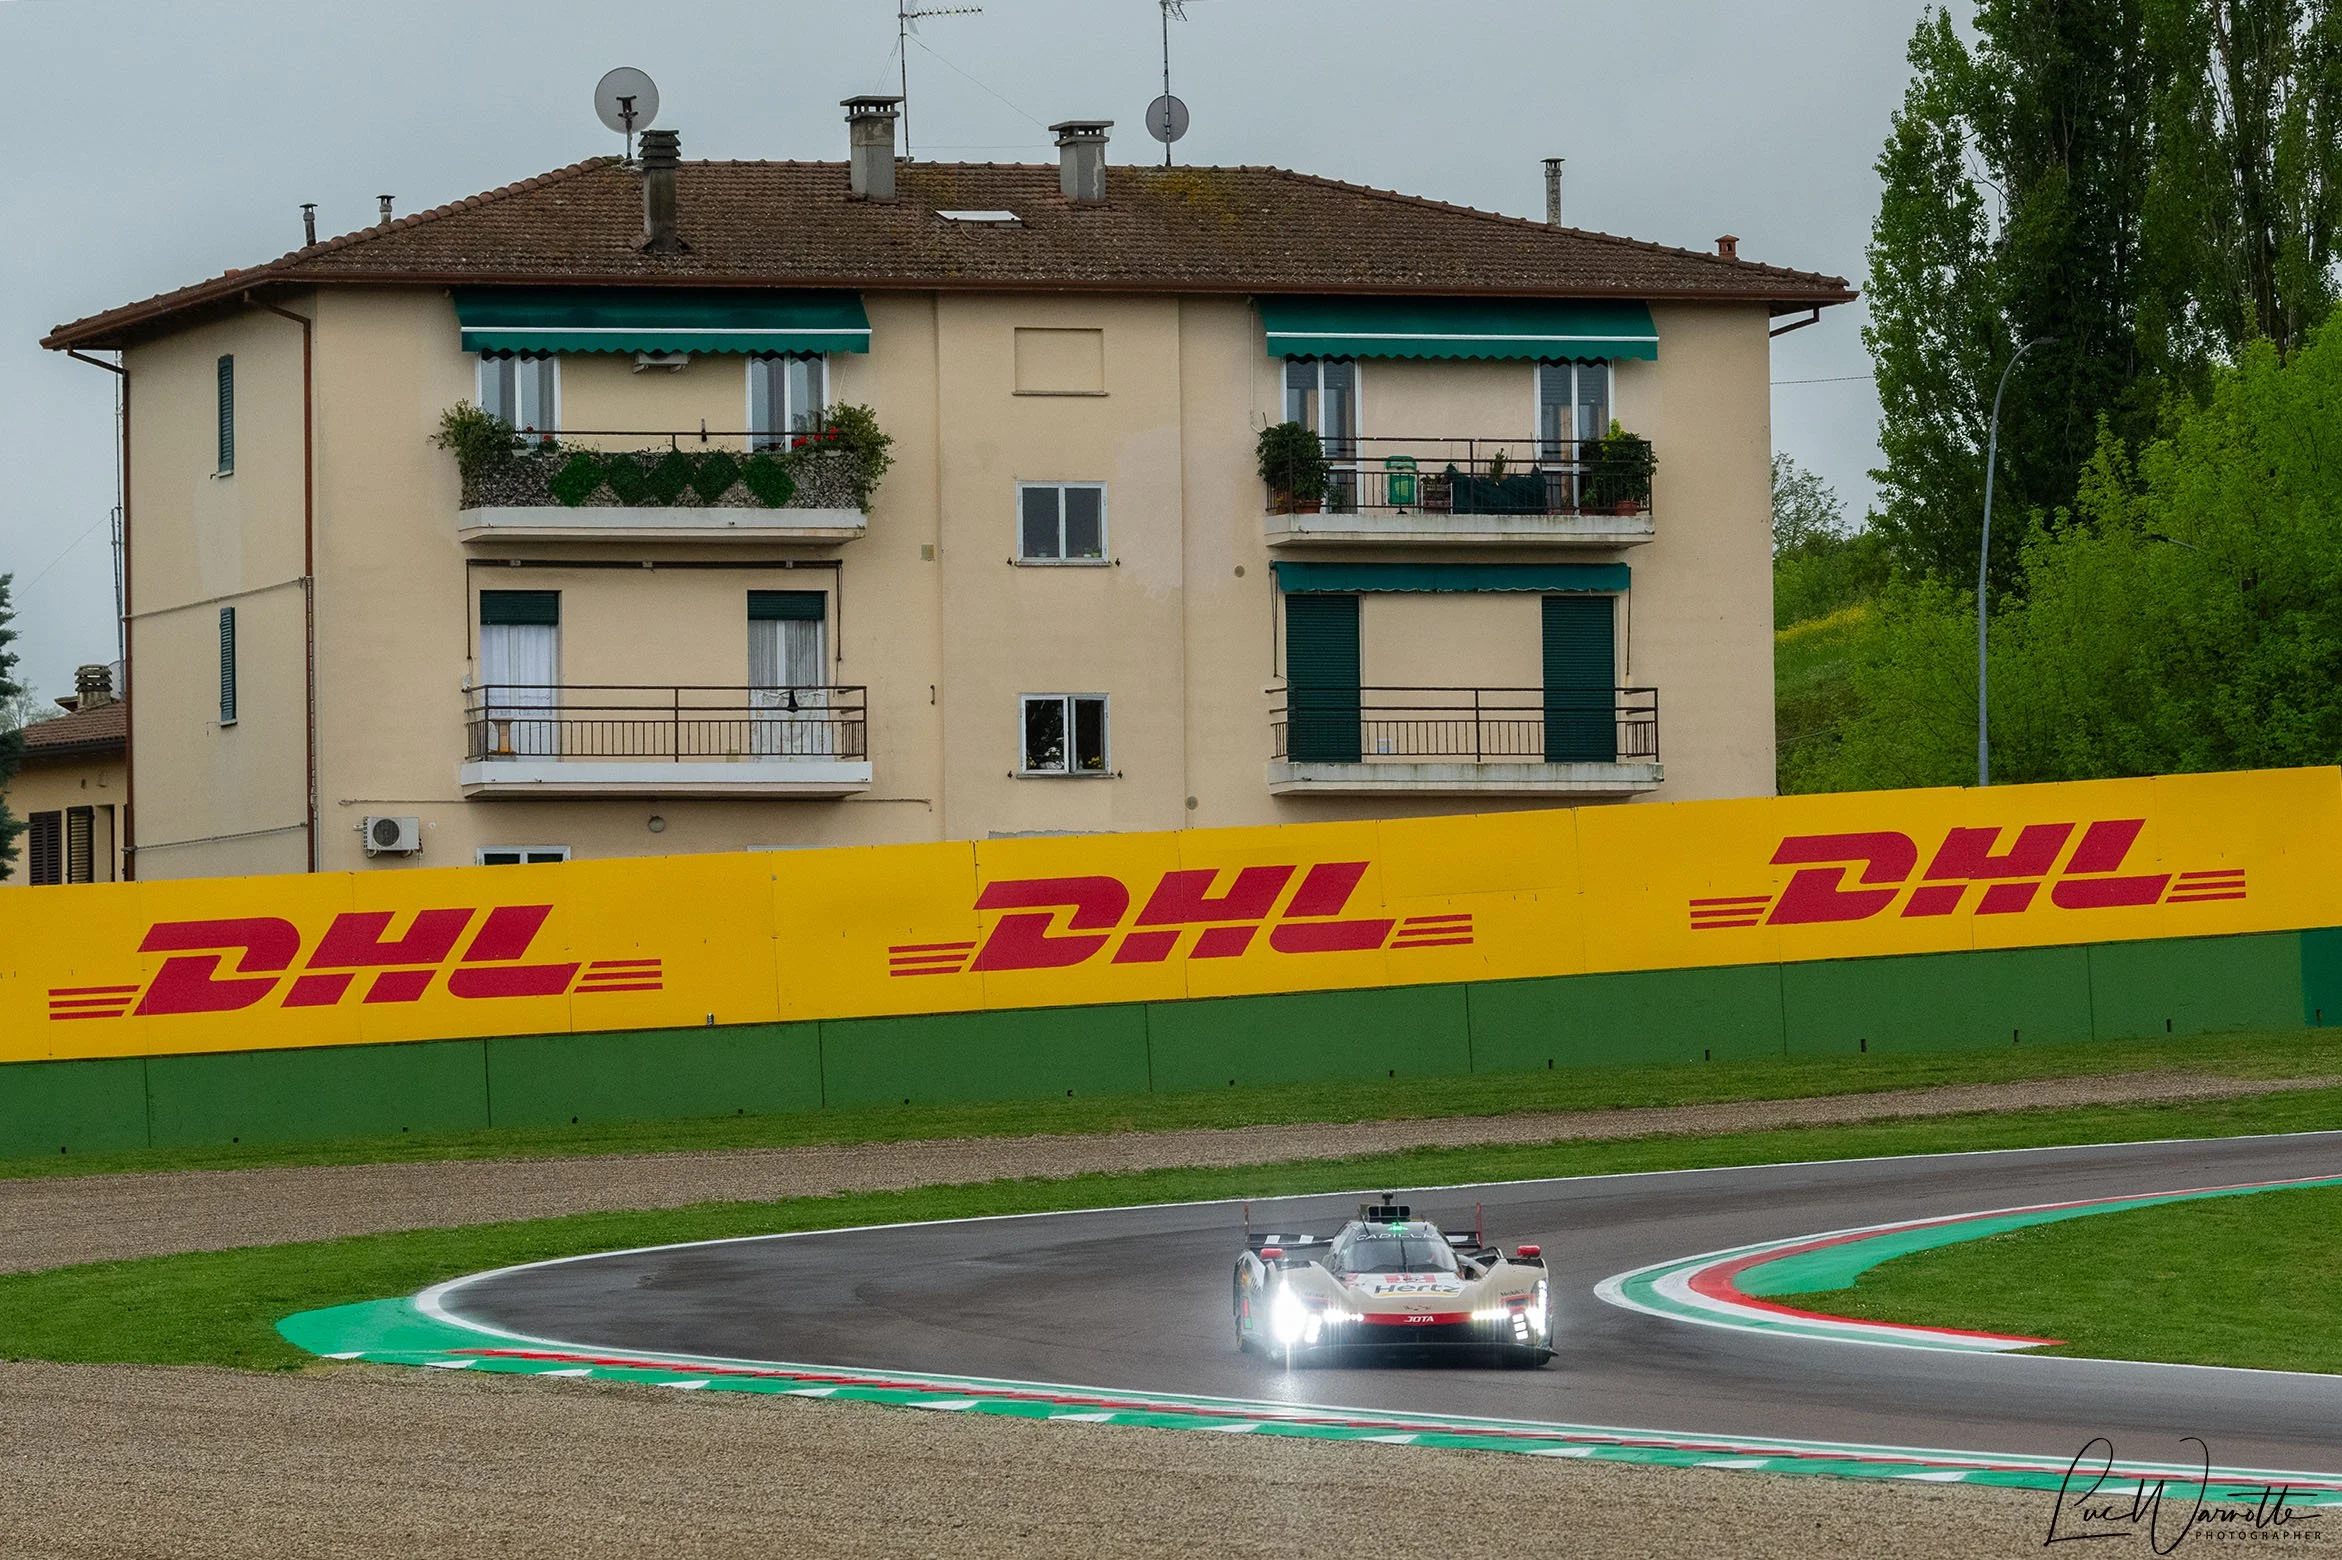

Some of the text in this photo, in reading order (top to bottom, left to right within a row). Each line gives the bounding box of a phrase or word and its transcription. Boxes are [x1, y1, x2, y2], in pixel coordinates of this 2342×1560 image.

[969, 861, 1396, 972] DHL
[1765, 819, 2172, 925] DHL
[132, 904, 580, 1016] DHL
[1374, 1284, 1460, 1294] Hertz
